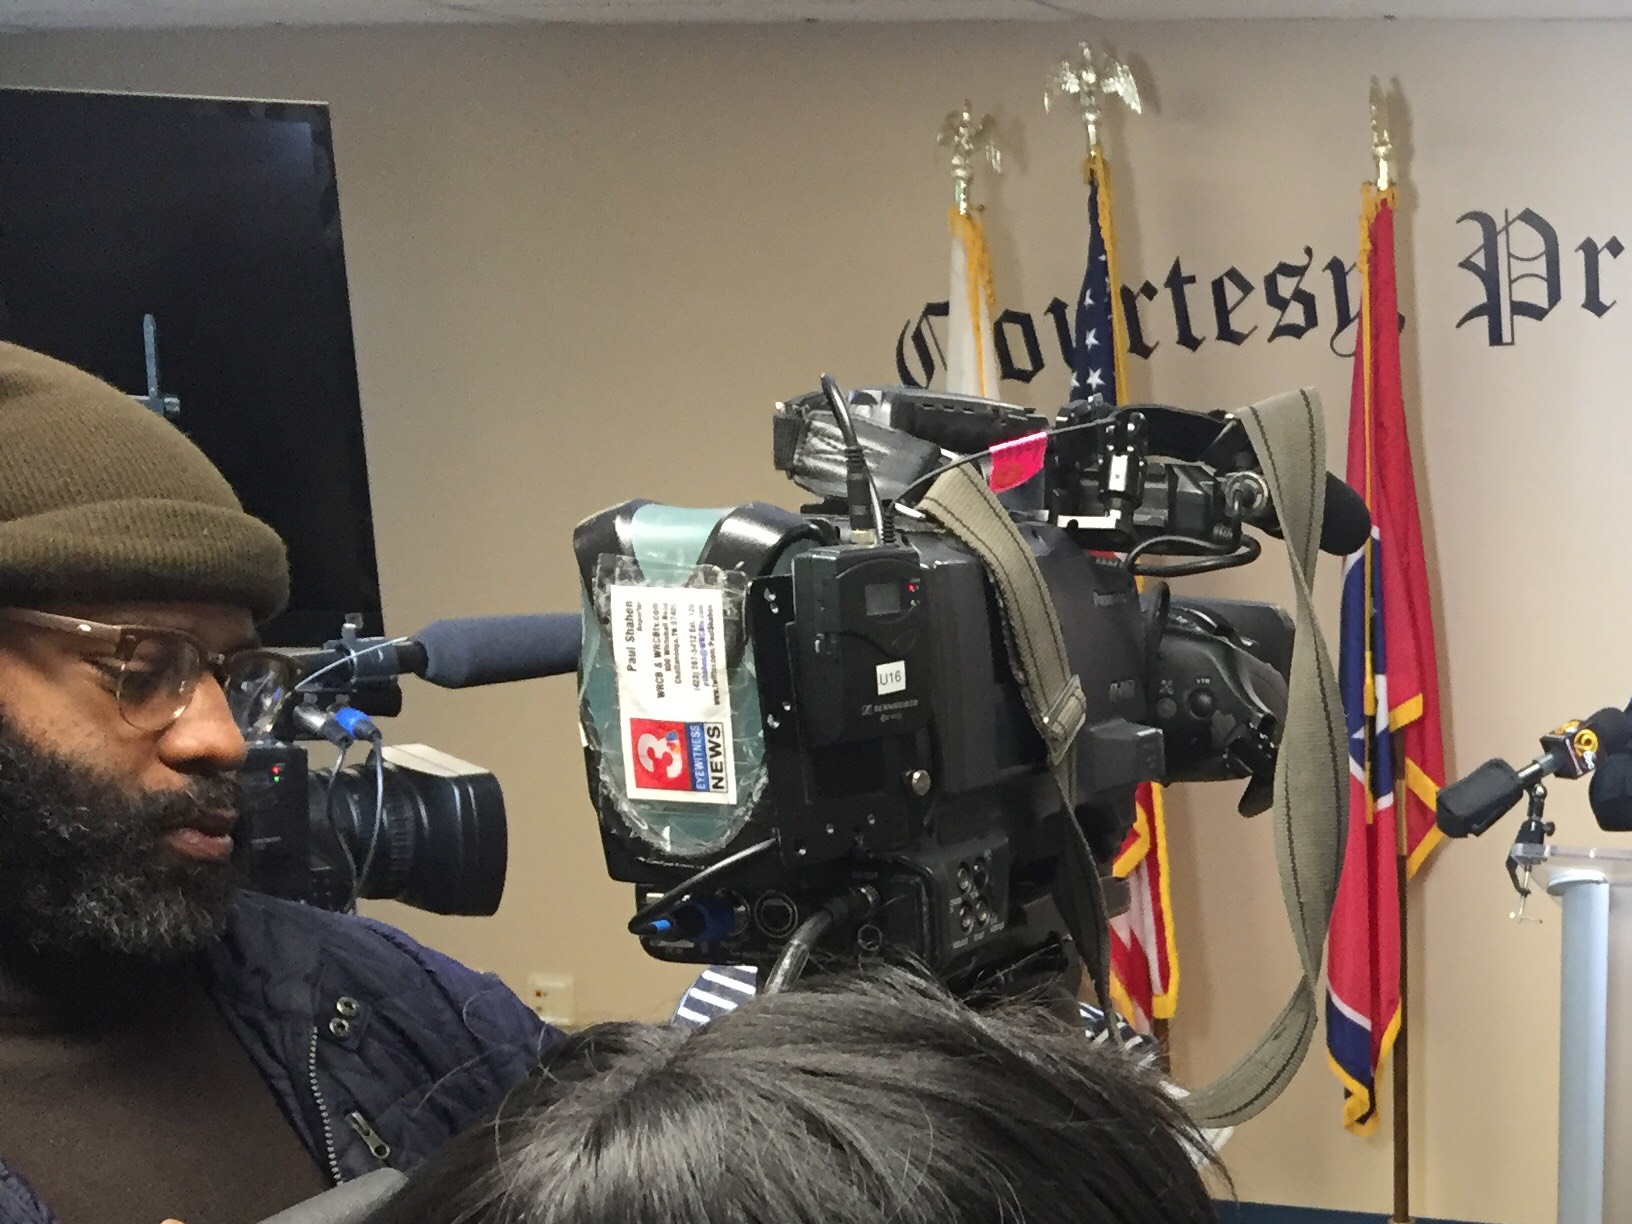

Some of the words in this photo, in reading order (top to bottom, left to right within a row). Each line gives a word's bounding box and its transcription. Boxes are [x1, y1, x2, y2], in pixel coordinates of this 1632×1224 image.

[896, 245, 1405, 389] Cortesy
[626, 647, 637, 672] Paul
[879, 669, 902, 686] U16
[637, 732, 683, 779] 3
[690, 725, 706, 790] EYEWITNESS
[707, 725, 725, 790] NEWS
